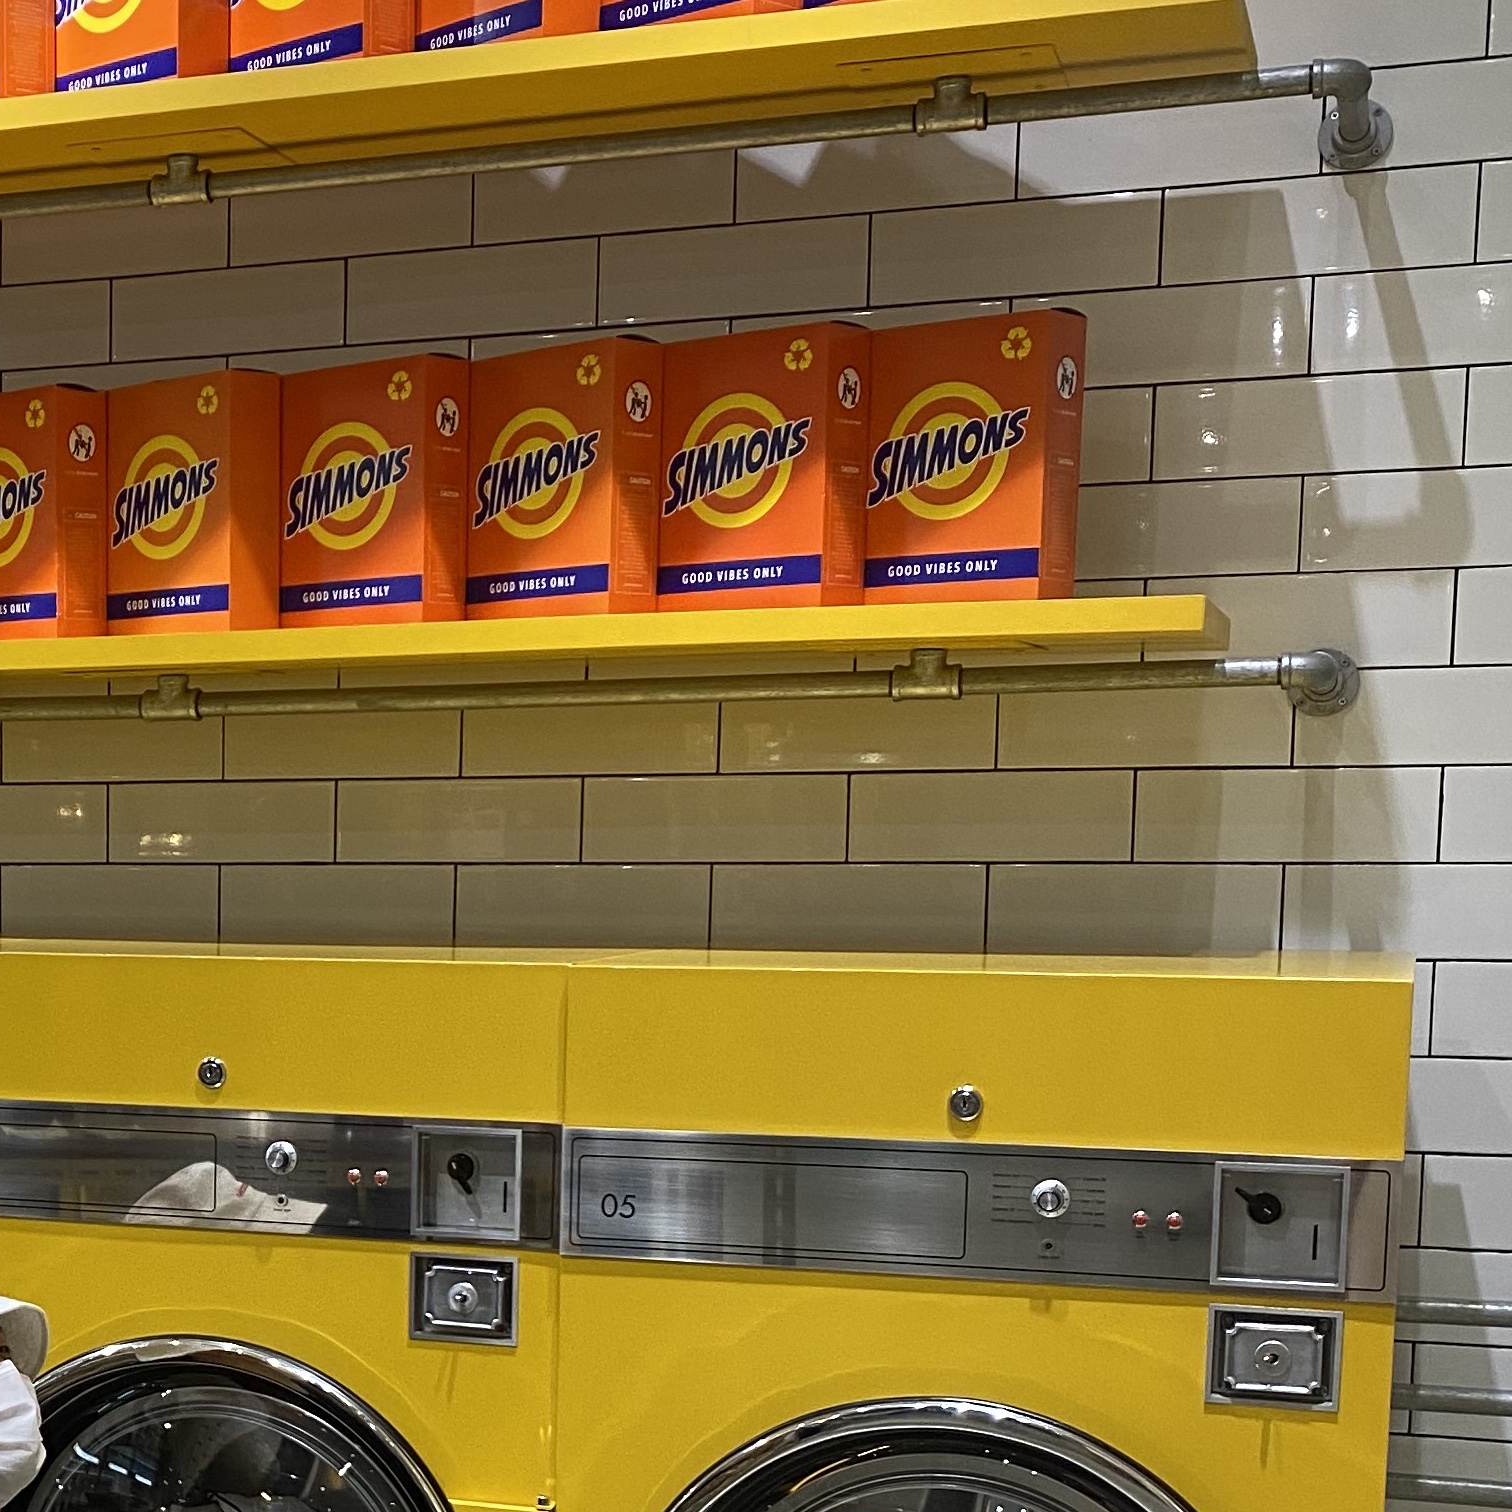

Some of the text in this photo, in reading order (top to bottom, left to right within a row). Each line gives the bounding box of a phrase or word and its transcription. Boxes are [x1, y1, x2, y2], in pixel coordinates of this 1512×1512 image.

[619, 3, 649, 22] GOOD
[430, 15, 512, 50] GOOD VIBES ONLY
[247, 40, 332, 72] GOOD VIBES ONLY
[68, 63, 148, 92] GOOD VIBES ONLY
[662, 417, 812, 519] SIMMONS
[866, 406, 1030, 509] SIMMONS
[284, 444, 412, 539] SIMMONS
[472, 430, 601, 530] SIMMONS
[111, 458, 219, 549] SIMMONS
[681, 565, 783, 585] GOOD VIBES ONLY
[887, 558, 998, 578] GOOD VIBES ONLY
[302, 585, 390, 603] GOOD VIBES ONLY
[489, 575, 576, 593] GOOD VIBES ONLY
[10, 602, 30, 614] ONLY
[126, 594, 201, 611] GOOD VIBES ONLY
[601, 1193, 636, 1218] 05
